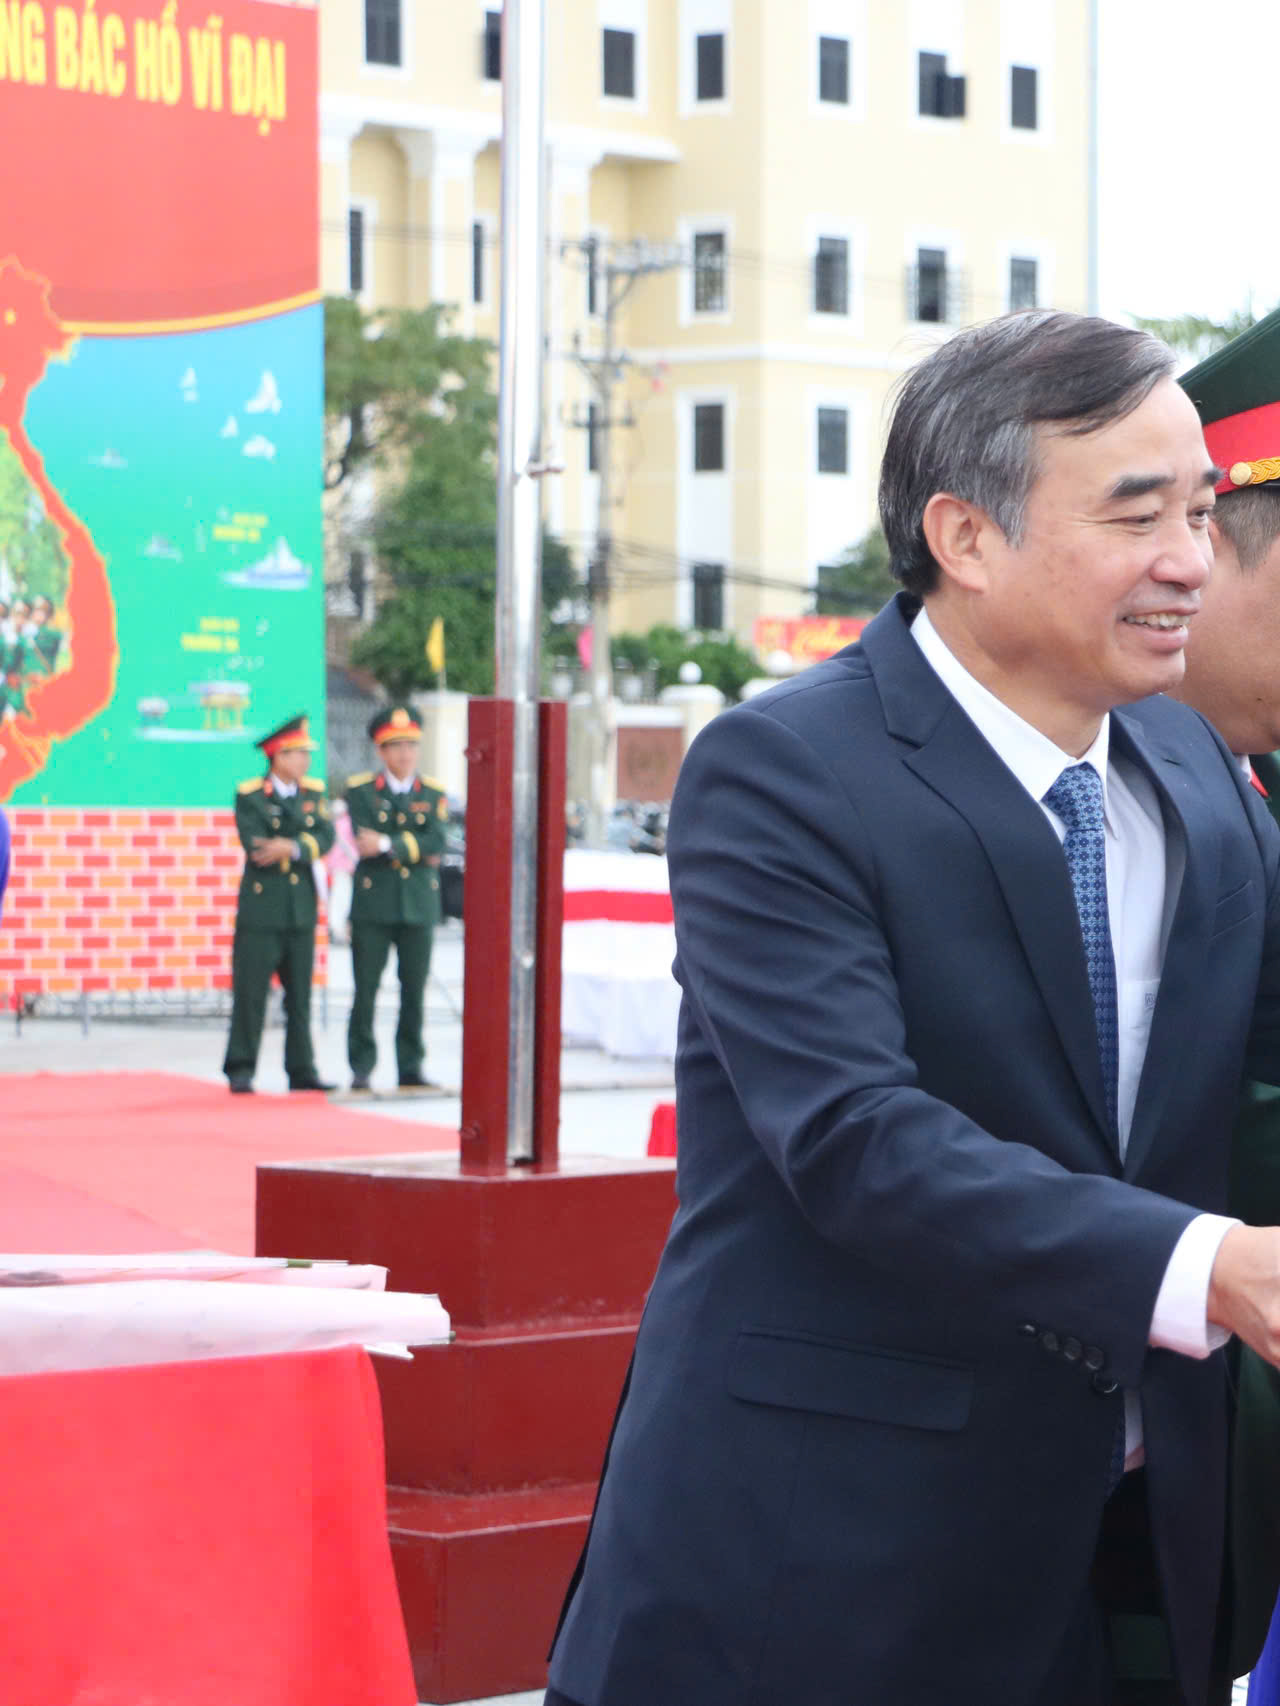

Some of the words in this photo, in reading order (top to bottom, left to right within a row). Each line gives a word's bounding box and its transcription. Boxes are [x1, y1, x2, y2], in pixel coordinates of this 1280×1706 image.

[54, 0, 126, 98] BÁC
[188, 14, 223, 112] VĨ
[229, 33, 286, 136] ĐẠI
